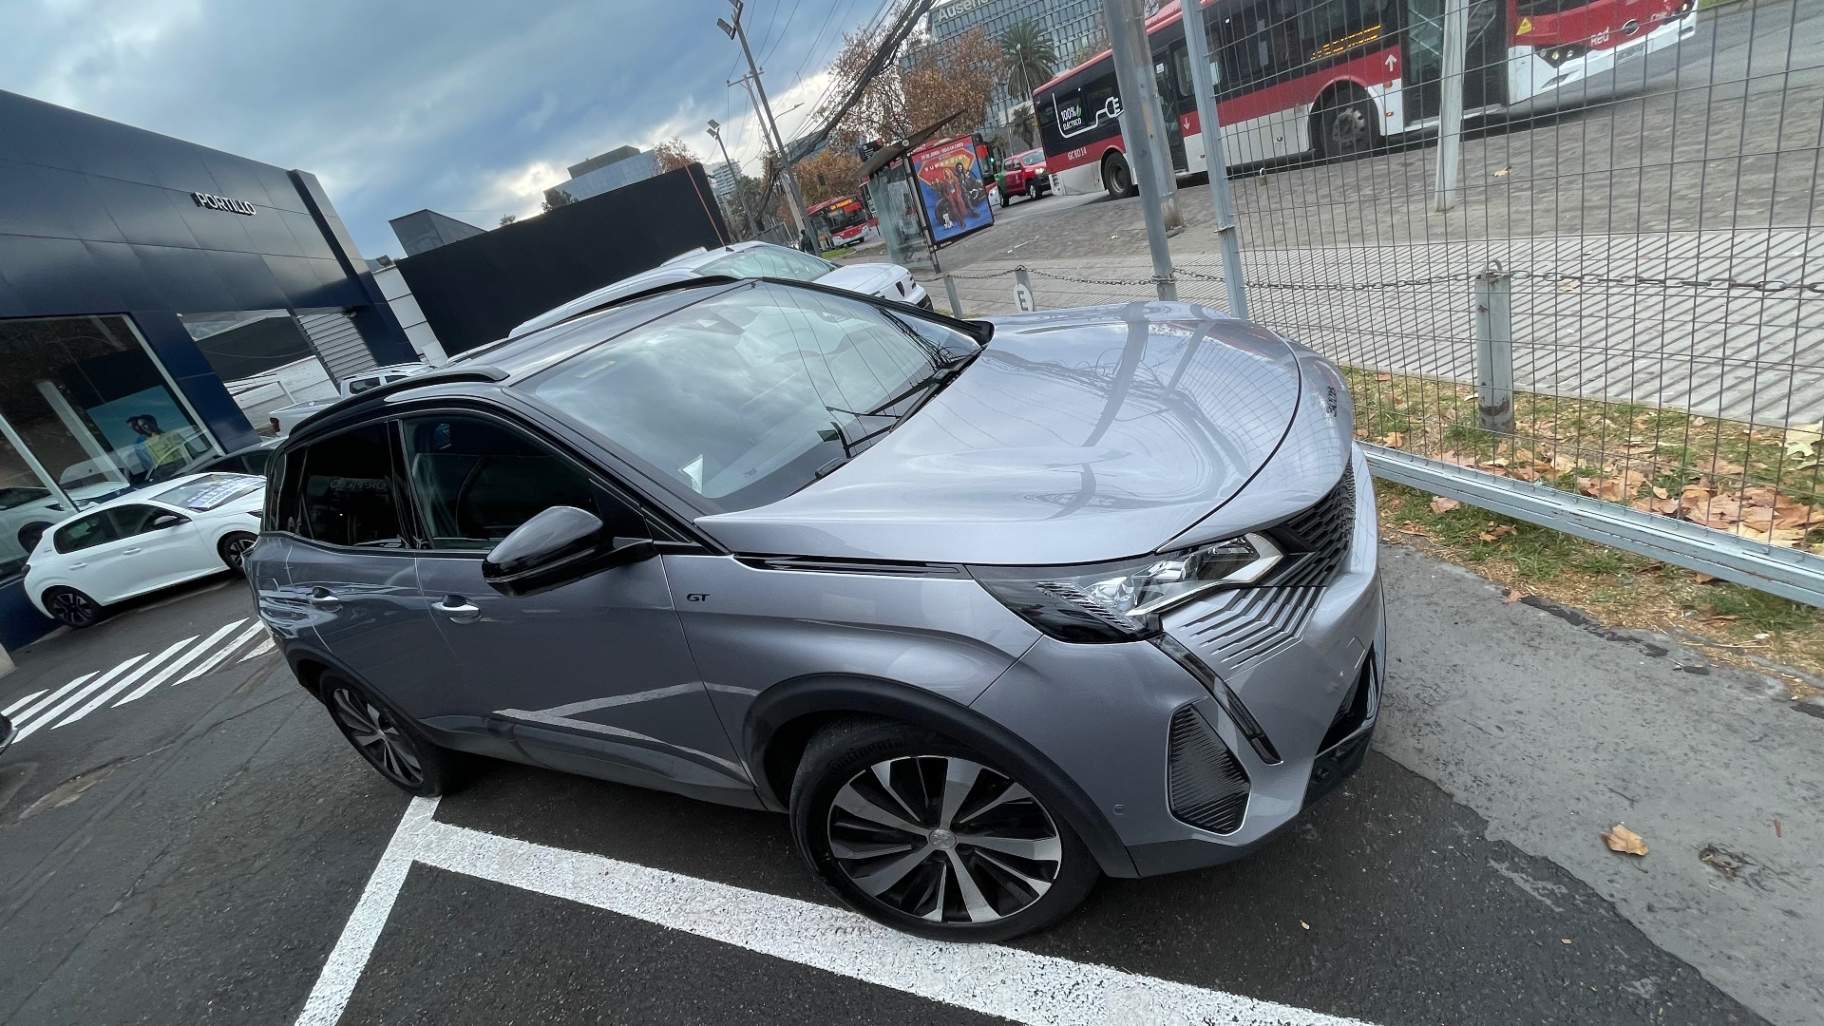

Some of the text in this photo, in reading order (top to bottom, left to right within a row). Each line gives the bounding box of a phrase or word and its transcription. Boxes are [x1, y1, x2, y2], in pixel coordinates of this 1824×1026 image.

[1590, 26, 1610, 47] Red
[1061, 106, 1077, 122] 100%
[193, 192, 257, 215] PORTILLO
[1016, 290, 1029, 311] E
[686, 593, 711, 602] GT
